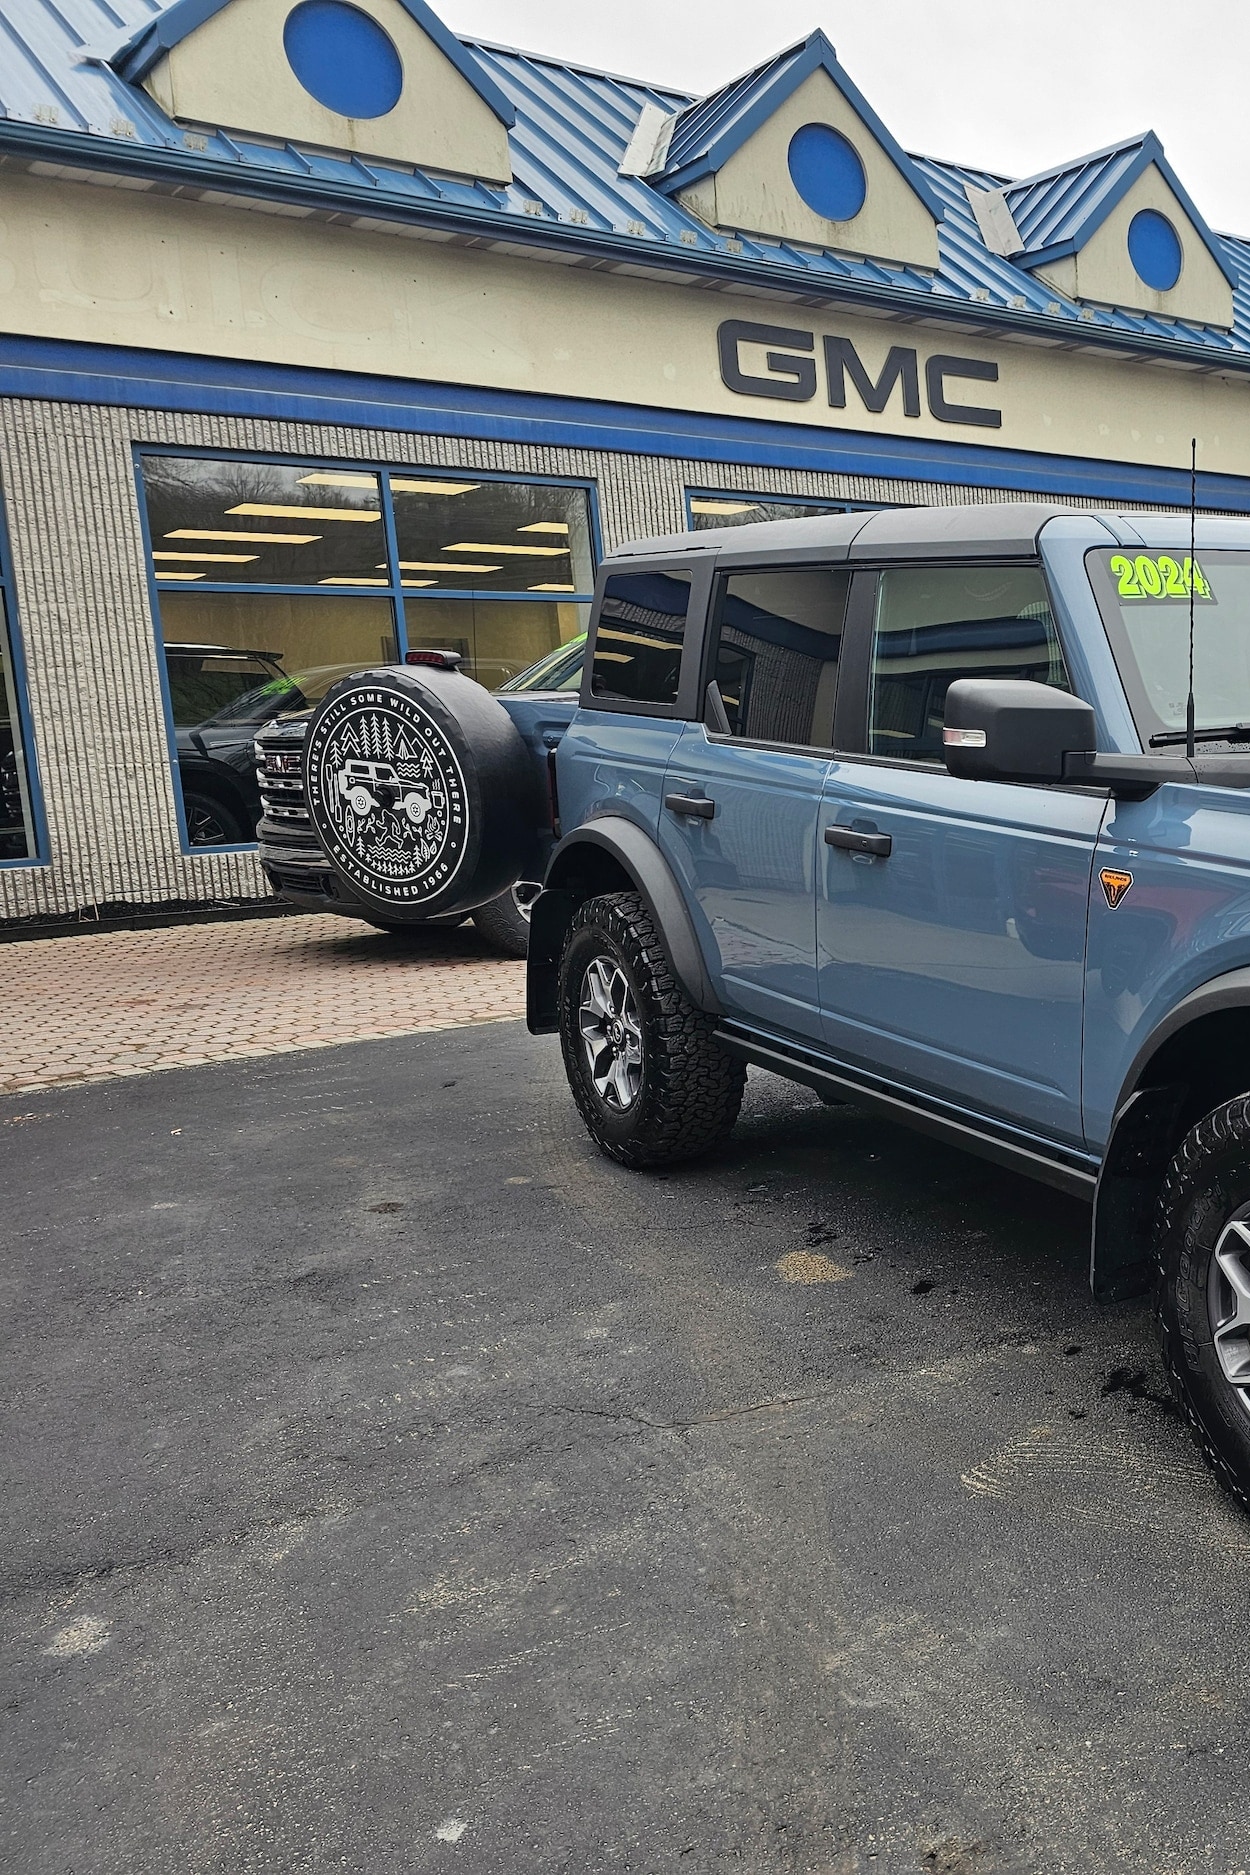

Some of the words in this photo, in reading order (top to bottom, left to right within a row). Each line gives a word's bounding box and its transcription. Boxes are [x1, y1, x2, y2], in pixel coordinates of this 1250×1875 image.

[716, 319, 1002, 428] GMC
[1110, 555, 1212, 600] 2024
[311, 740, 322, 806] THERE'S
[320, 704, 346, 735] STILL
[350, 693, 383, 706] SOME
[390, 697, 421, 723] WILD
[424, 727, 446, 757] OUT
[445, 766, 462, 824] THERE
[333, 845, 418, 896] ESTABLISHED
[423, 862, 448, 889] 1966
